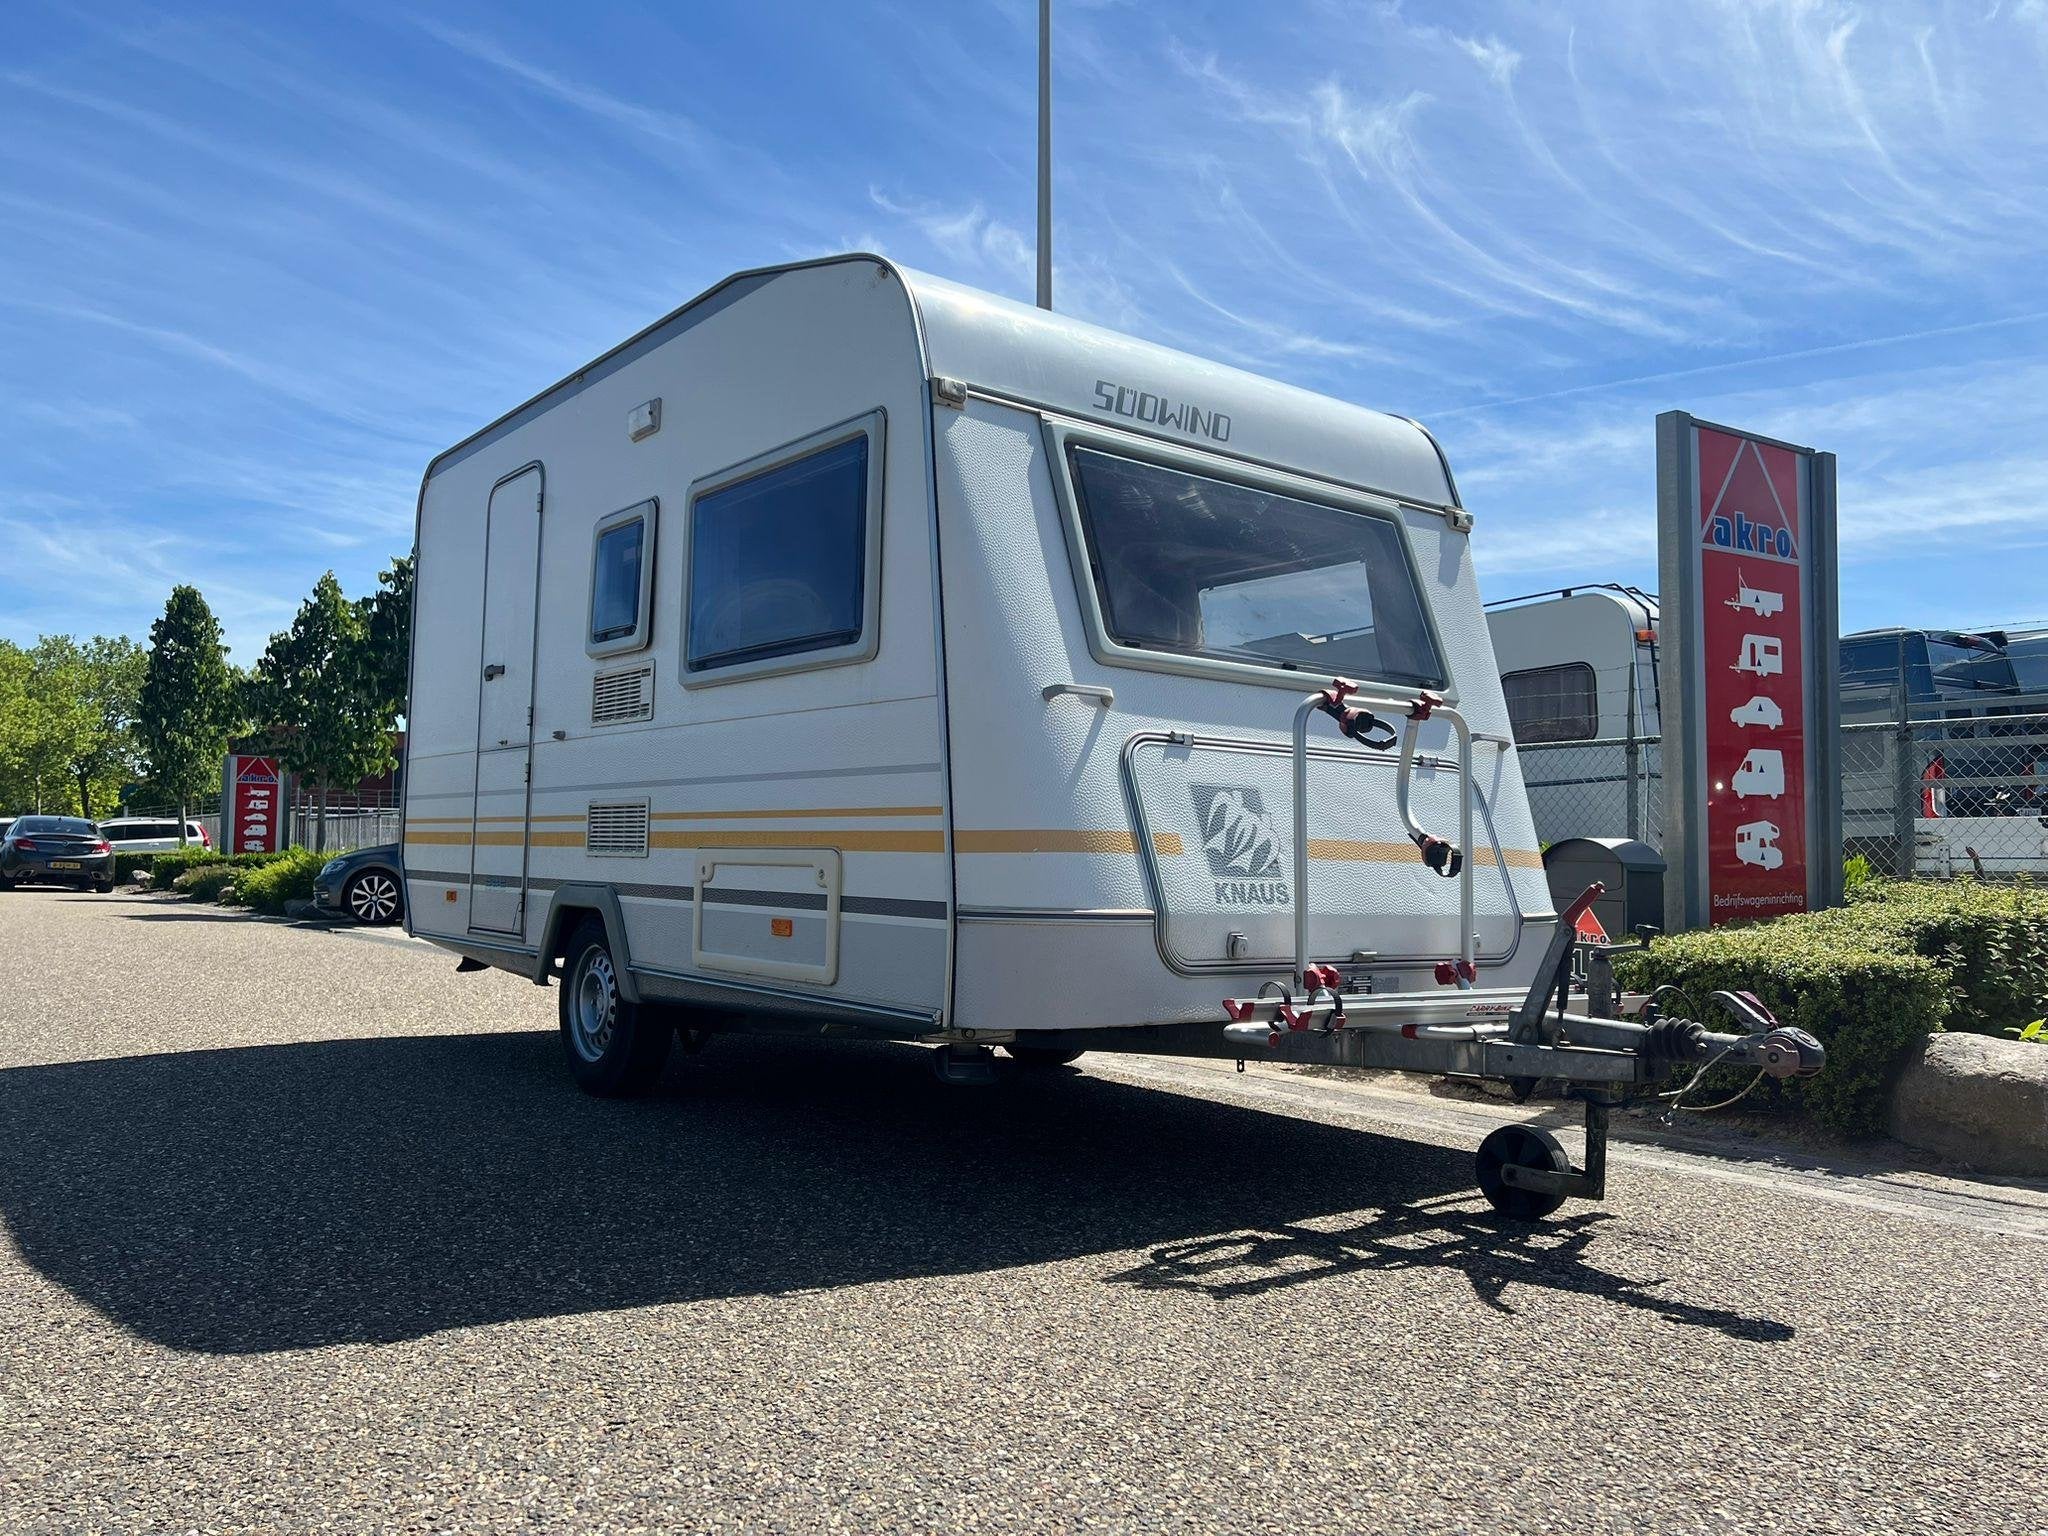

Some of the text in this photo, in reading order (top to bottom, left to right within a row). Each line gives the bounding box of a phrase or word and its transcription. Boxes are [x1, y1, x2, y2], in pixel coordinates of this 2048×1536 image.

[1093, 380, 1231, 442] SÜDWIND
[1712, 511, 1792, 559] akro
[241, 773, 276, 783] akro
[1214, 882, 1290, 905] KNAUS
[1713, 892, 1804, 908] Bedrijfswageninrichting
[1577, 930, 1607, 944] kro
